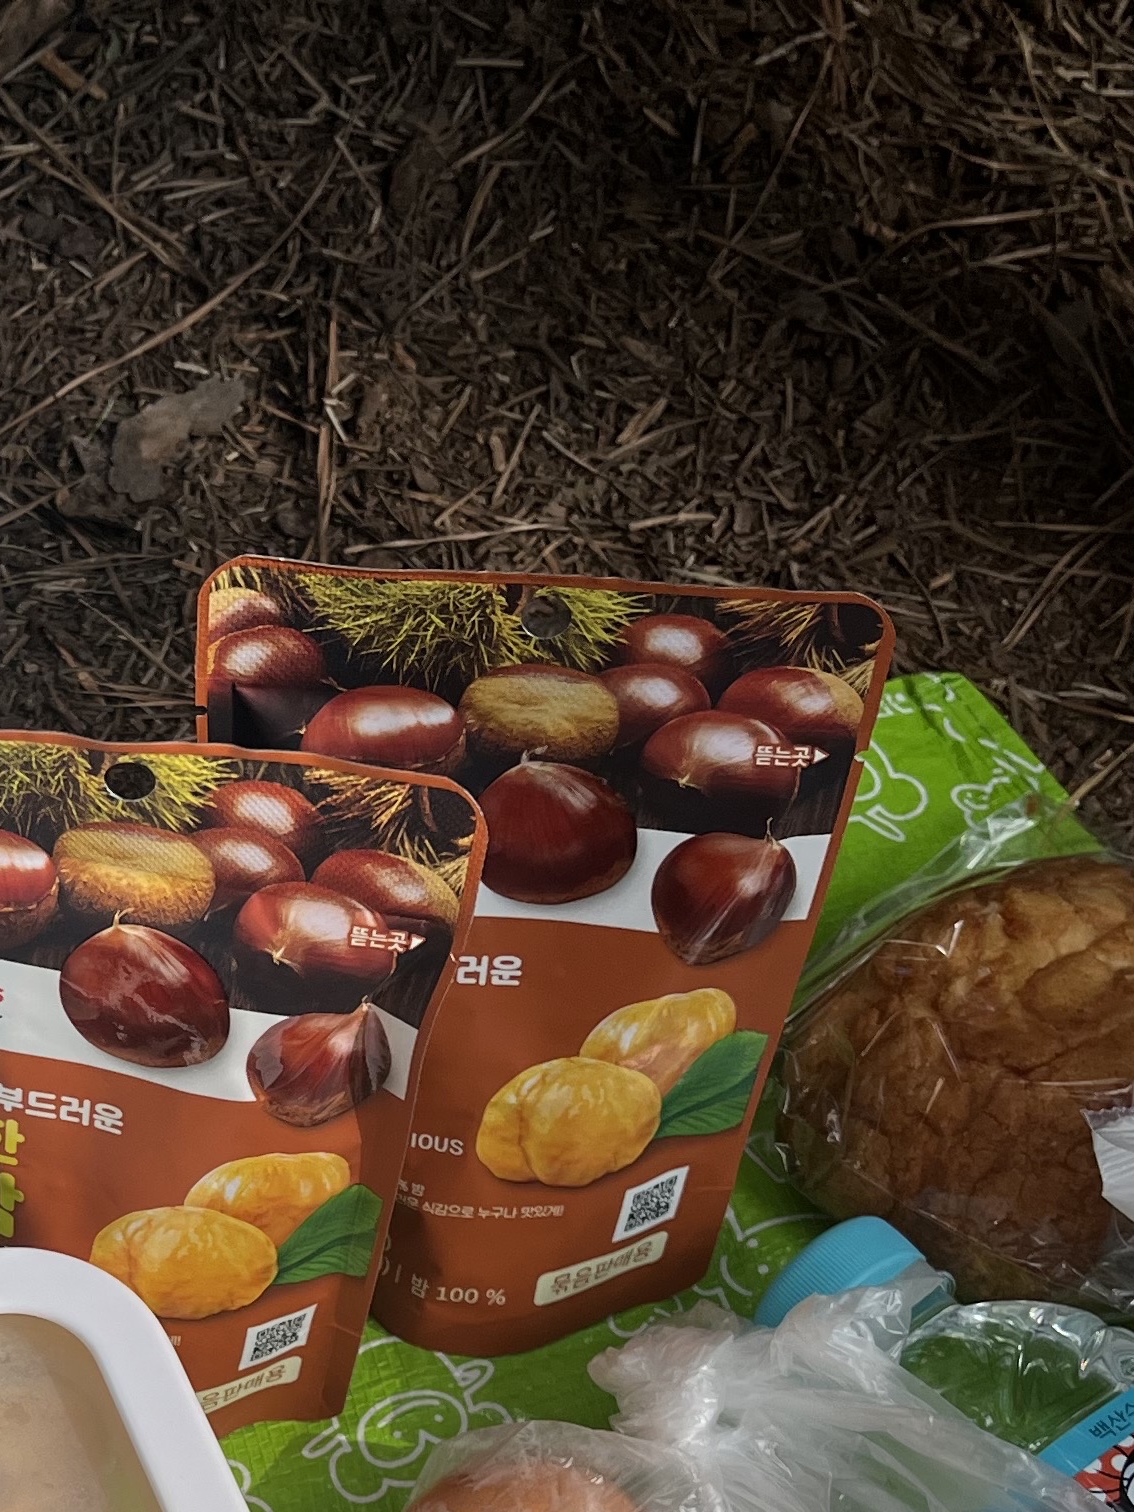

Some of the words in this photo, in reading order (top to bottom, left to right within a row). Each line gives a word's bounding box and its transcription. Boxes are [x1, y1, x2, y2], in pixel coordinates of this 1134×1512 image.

[755, 745, 810, 768] 뜯는곳
[350, 925, 408, 953] 뜯는곳
[454, 954, 523, 987] 러운
[478, 1205, 518, 1220] 누구나
[435, 1285, 480, 1304] 100
